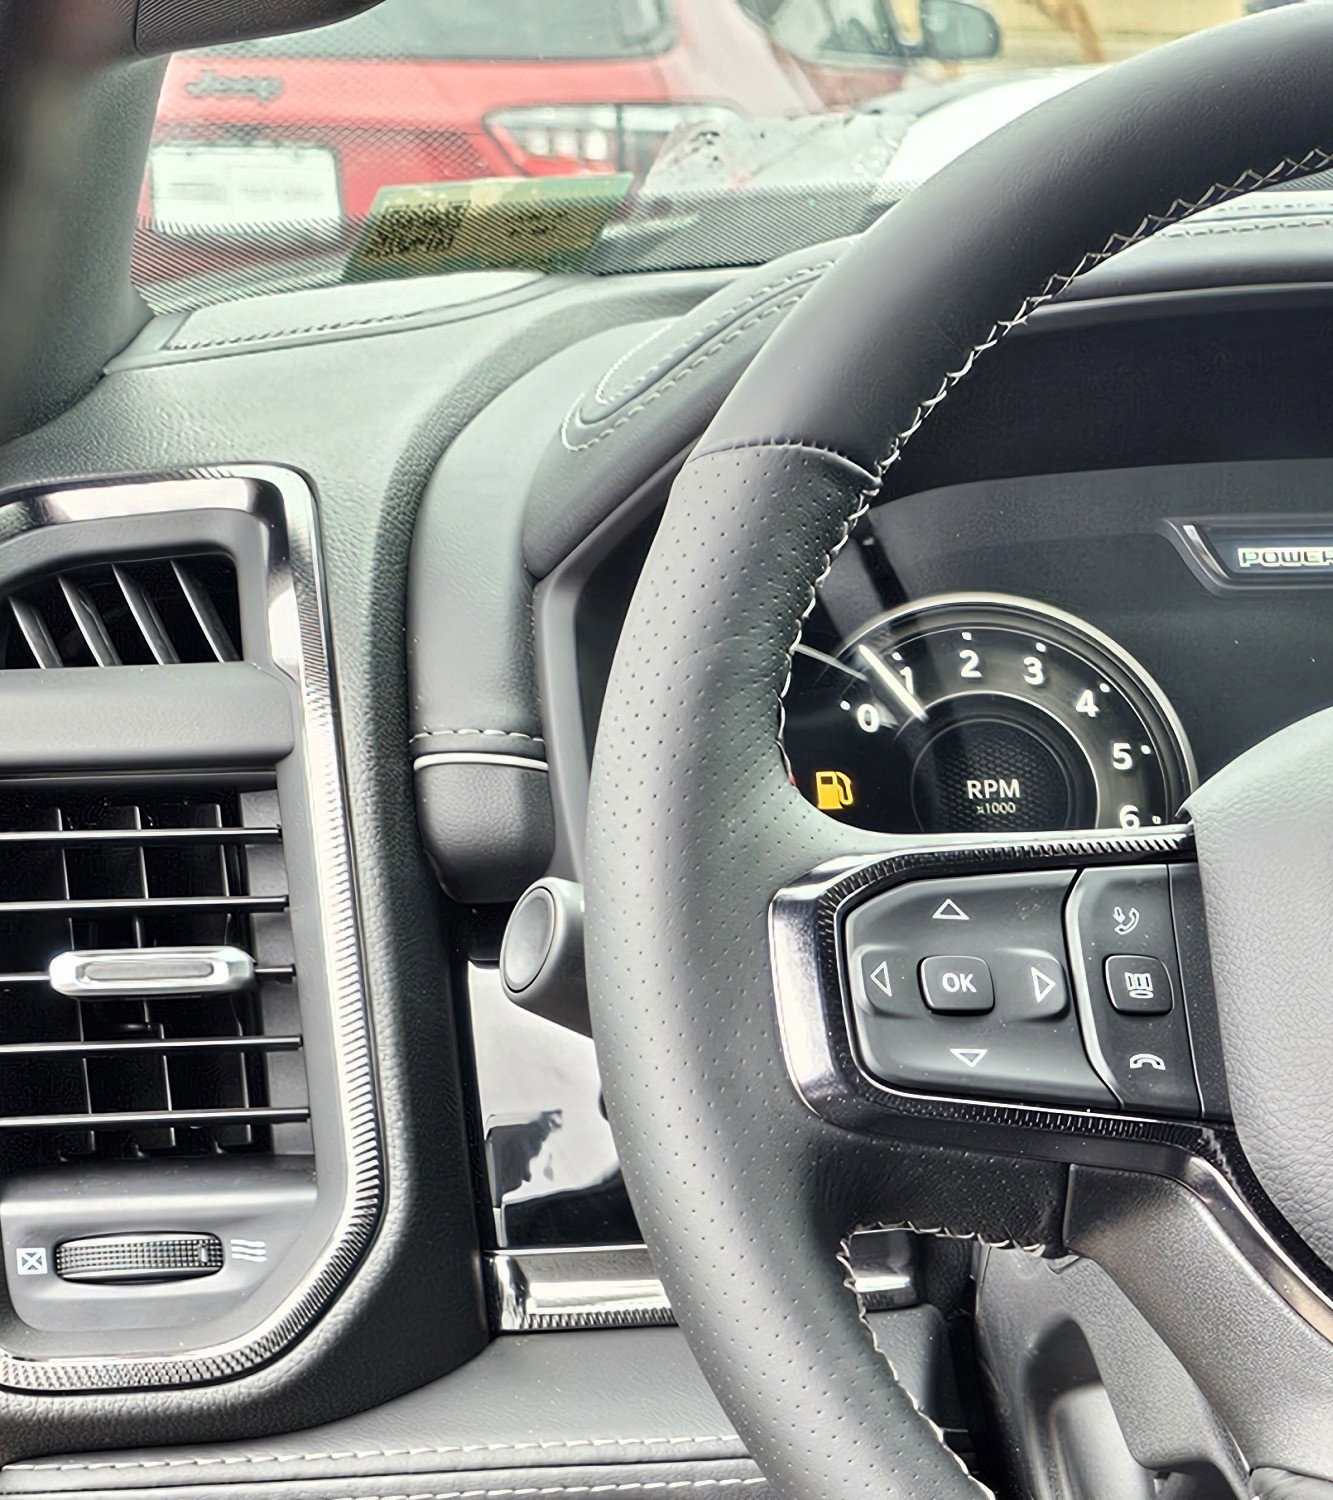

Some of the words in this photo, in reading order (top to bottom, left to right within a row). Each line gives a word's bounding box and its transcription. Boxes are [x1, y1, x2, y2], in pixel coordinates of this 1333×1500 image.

[959, 648, 983, 678] 2
[1023, 655, 1045, 686] 3
[899, 665, 915, 695] 1
[856, 702, 881, 734] 0
[1075, 688, 1100, 718] 4
[1112, 741, 1135, 771] 5
[966, 778, 1022, 800] RPM
[1119, 804, 1142, 831] 6
[941, 971, 977, 994] OK
